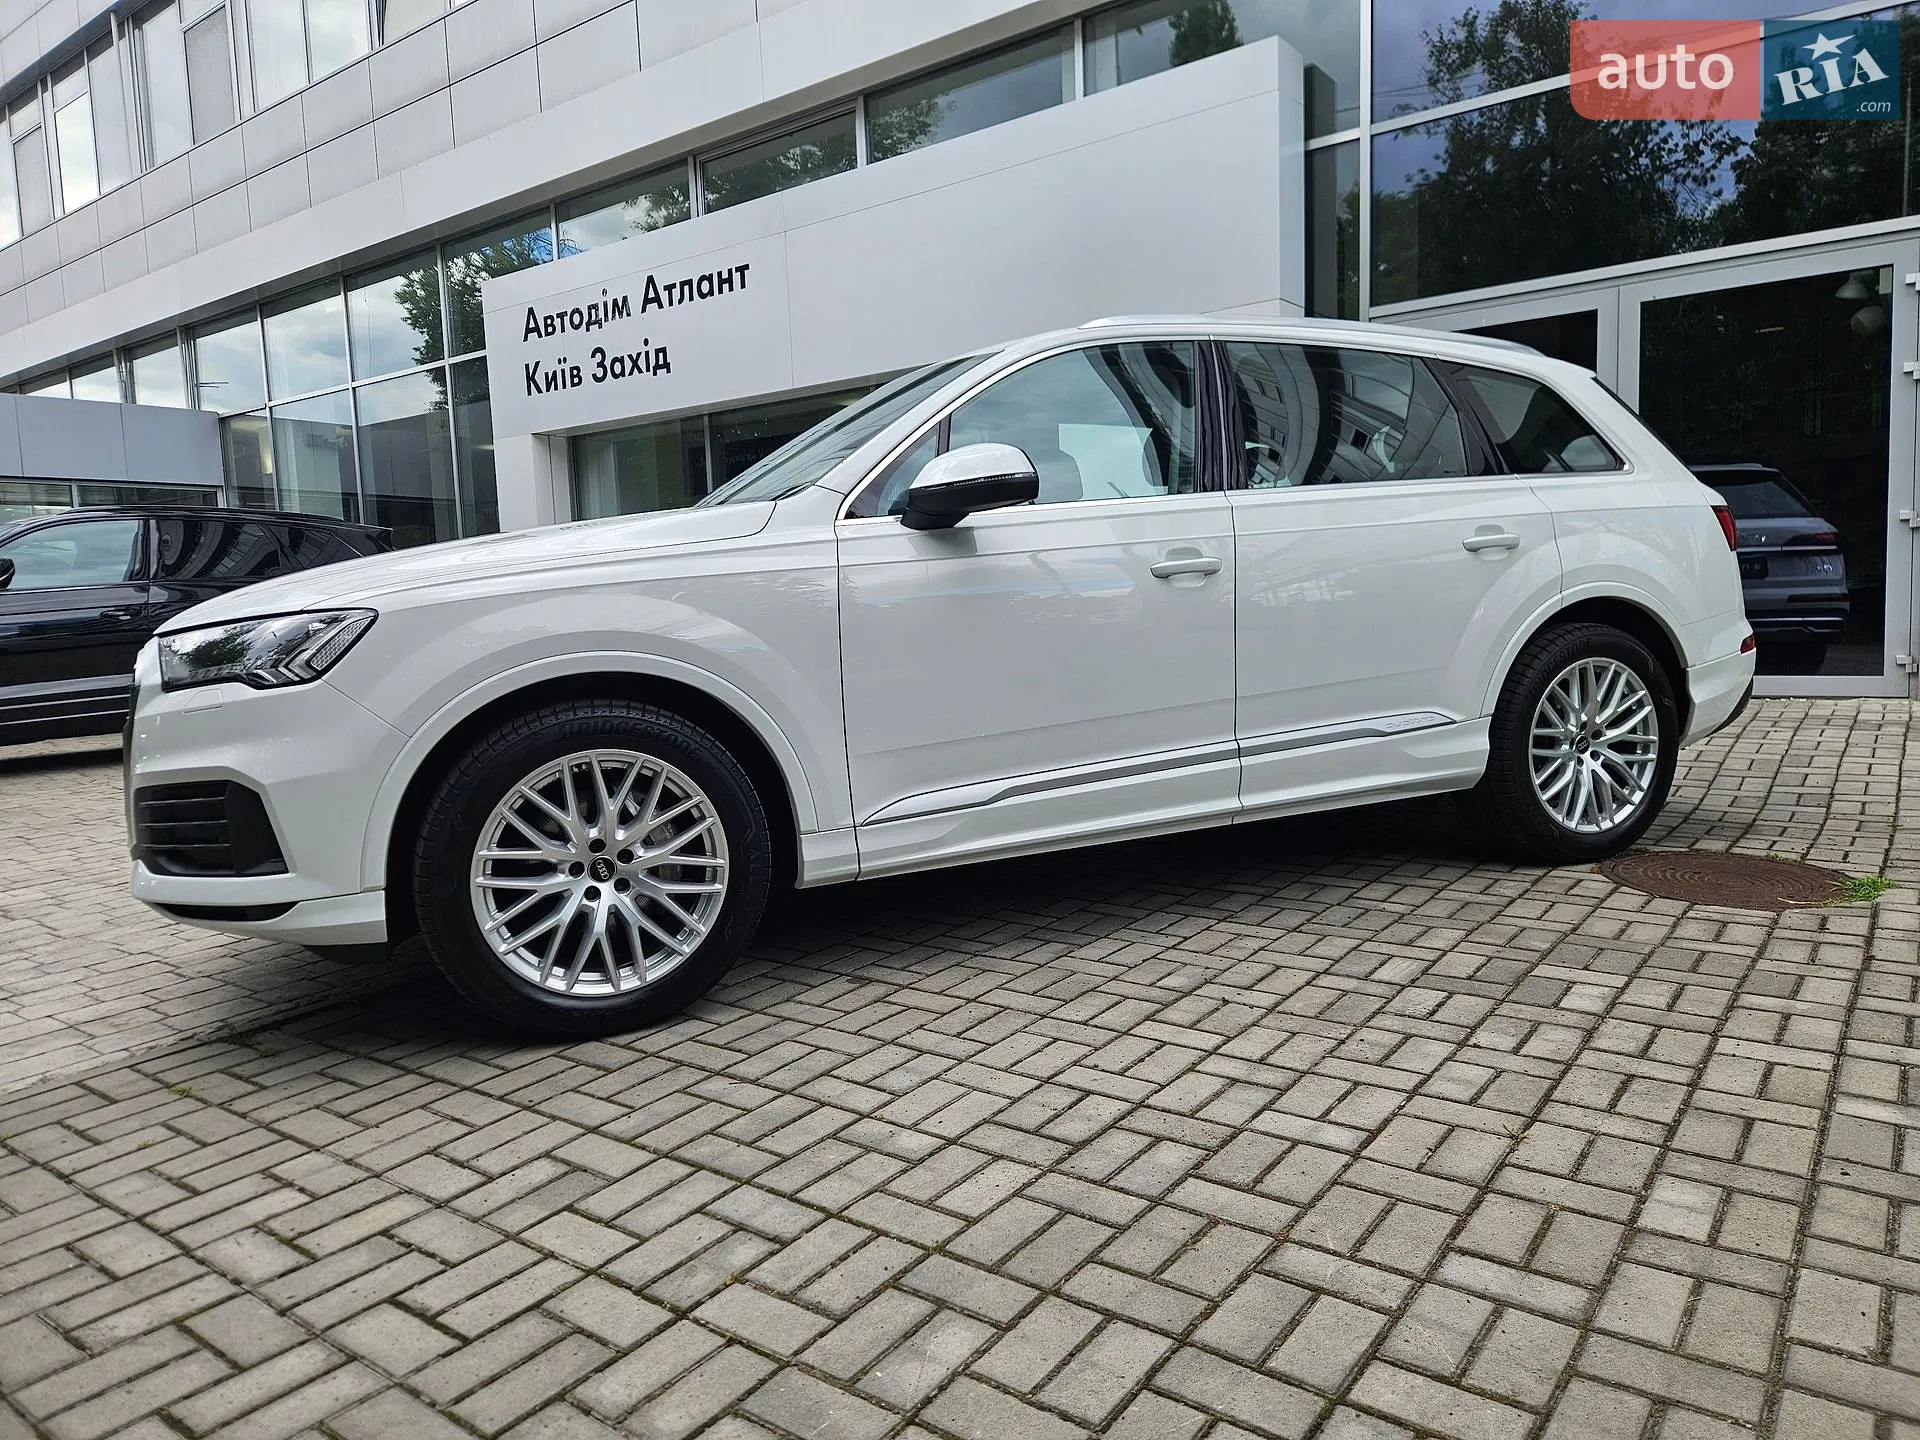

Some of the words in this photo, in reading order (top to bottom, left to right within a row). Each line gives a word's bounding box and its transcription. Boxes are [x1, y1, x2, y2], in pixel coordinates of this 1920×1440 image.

[522, 287, 632, 343] Автодім
[640, 263, 751, 314] Атлант
[524, 356, 583, 397] Київ
[590, 338, 672, 384] Захід
